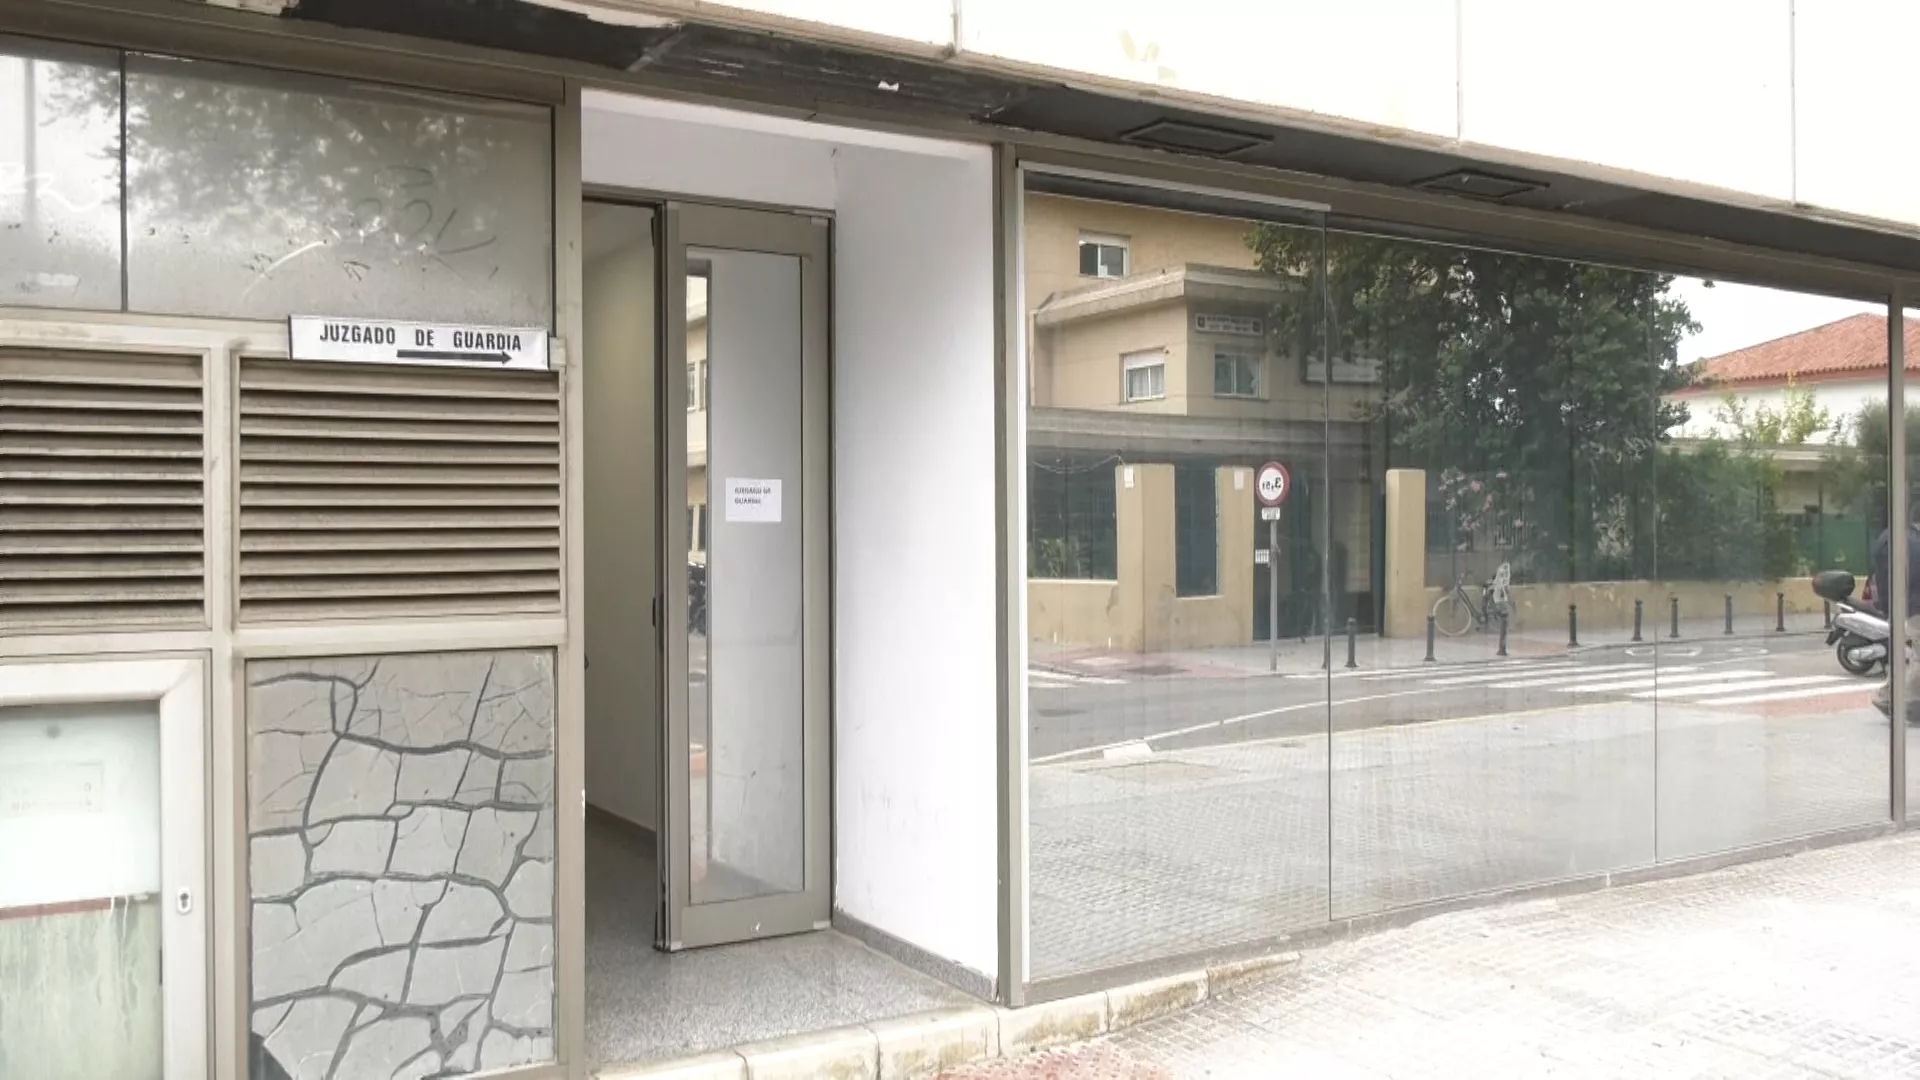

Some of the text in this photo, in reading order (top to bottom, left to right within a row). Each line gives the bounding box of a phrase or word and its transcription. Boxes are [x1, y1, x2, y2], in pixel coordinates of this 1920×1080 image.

[320, 324, 521, 351] JUZGADO DE GUARDIA
